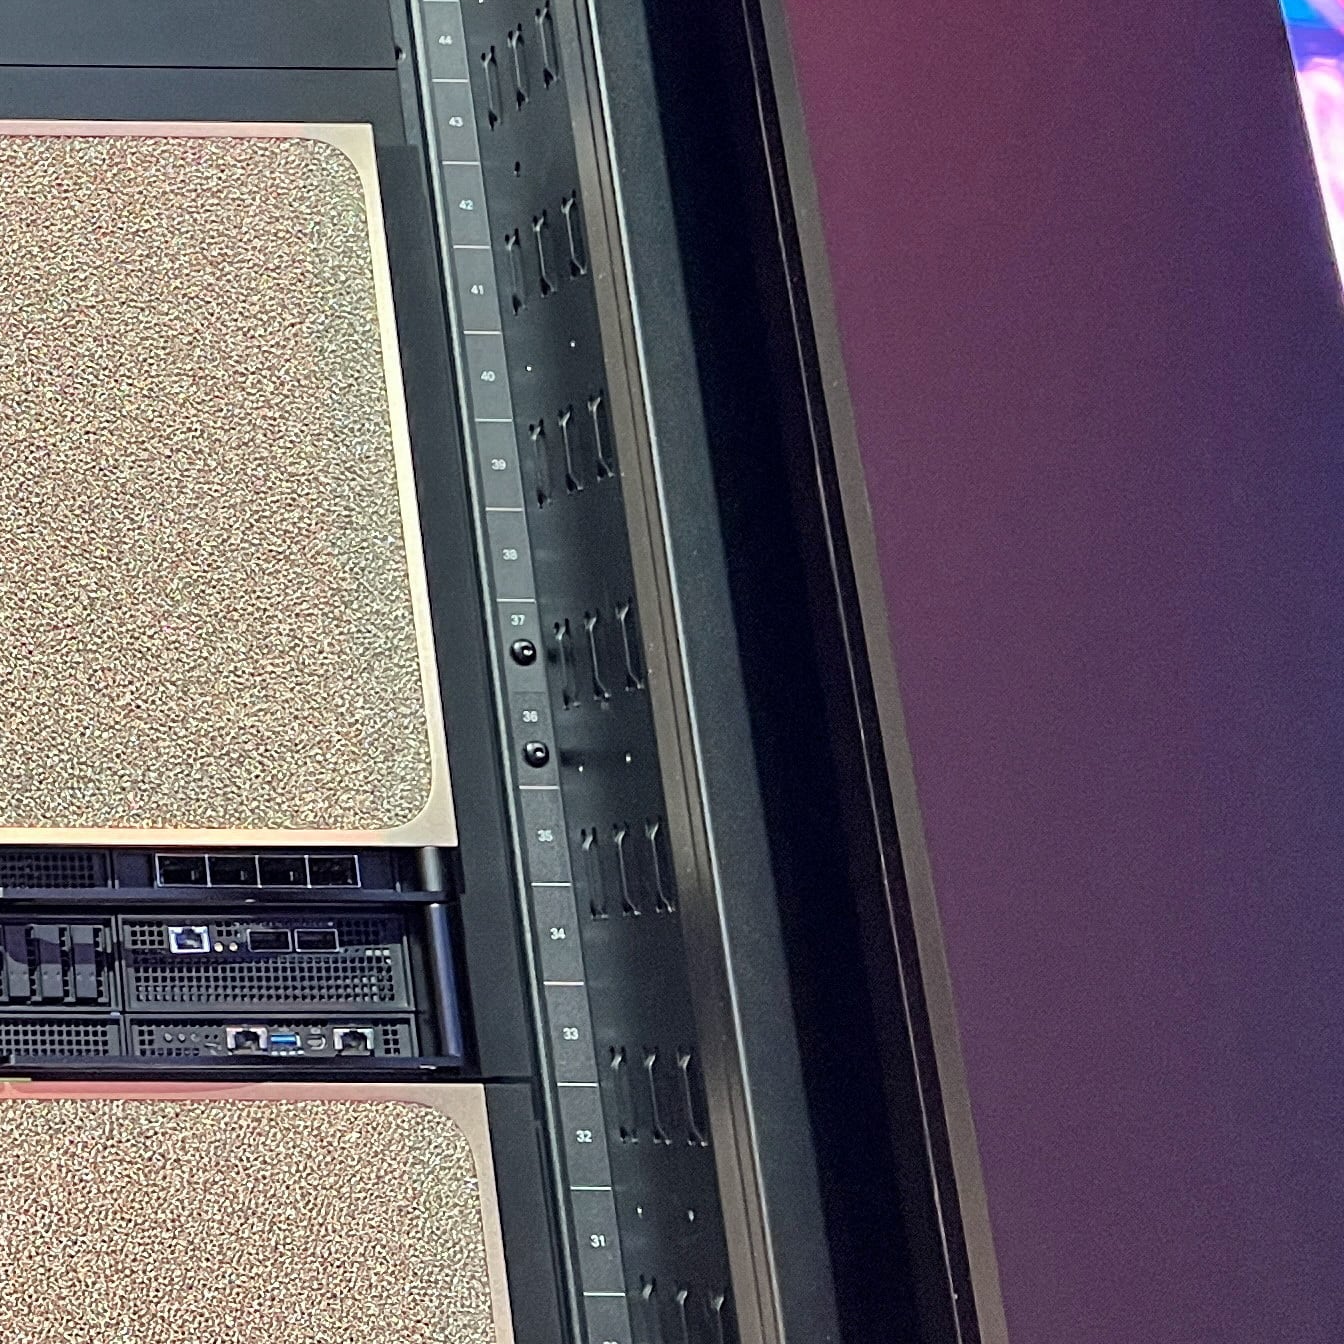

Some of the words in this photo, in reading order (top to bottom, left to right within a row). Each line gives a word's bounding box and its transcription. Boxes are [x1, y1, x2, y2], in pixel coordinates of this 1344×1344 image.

[438, 35, 453, 45] 44
[448, 116, 464, 127] 43
[459, 199, 473, 211] 42
[470, 284, 484, 295] 41
[480, 370, 496, 382] 40
[491, 458, 507, 470] 39
[502, 549, 518, 561] 38
[510, 614, 526, 626] 37
[522, 710, 538, 723] 36
[537, 829, 554, 842] 35
[550, 927, 566, 940] 34
[562, 1027, 579, 1040] 33
[576, 1129, 592, 1143] 32
[590, 1234, 606, 1248] 31
